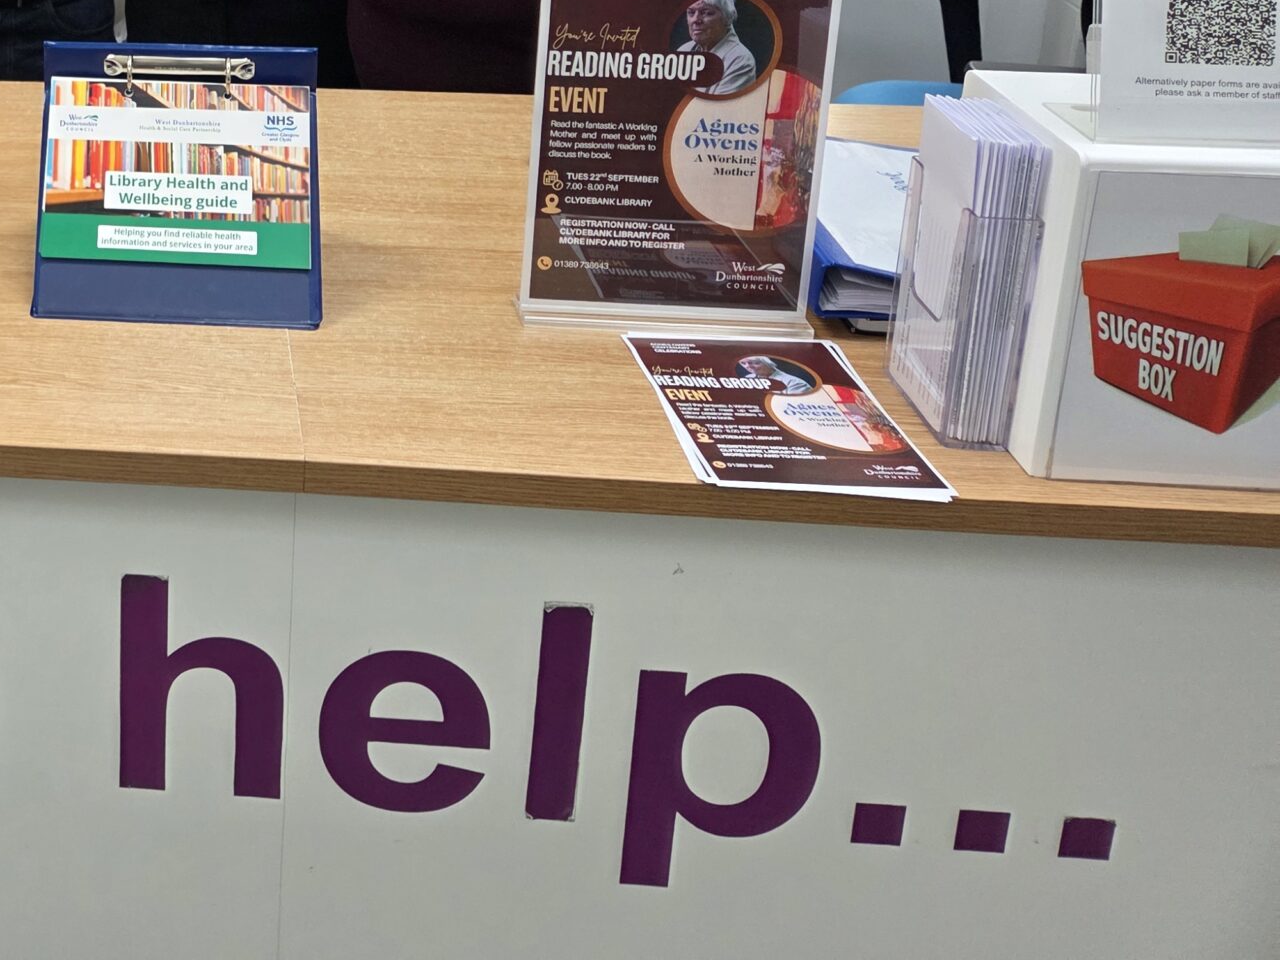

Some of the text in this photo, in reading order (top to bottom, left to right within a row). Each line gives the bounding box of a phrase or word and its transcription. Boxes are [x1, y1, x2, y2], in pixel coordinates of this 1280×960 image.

[548, 50, 706, 81] READING GROUP
[550, 86, 608, 114] EVENT
[267, 116, 294, 126] NHS
[694, 119, 760, 137] Agnes
[686, 134, 758, 150] Owens
[695, 154, 757, 166] A Working
[590, 173, 608, 181] 22nd
[608, 174, 659, 184] SEPTEMBER
[714, 168, 756, 176] Mother
[110, 176, 248, 190] Library Health and
[119, 192, 238, 210] Wellbeing guide
[564, 196, 652, 207] CLYDEBANK LIBRARY
[114, 228, 145, 238] Helping
[164, 230, 180, 238] find
[182, 231, 213, 239] reliable
[214, 232, 241, 240] health
[733, 262, 755, 272] West
[716, 272, 783, 283] Dunbartonshire
[1096, 311, 1224, 376] SUGGESTION
[654, 374, 771, 390] READING GROUP
[1138, 358, 1176, 402] BOX
[665, 390, 712, 402] EVENT
[120, 573, 1117, 886] help...
